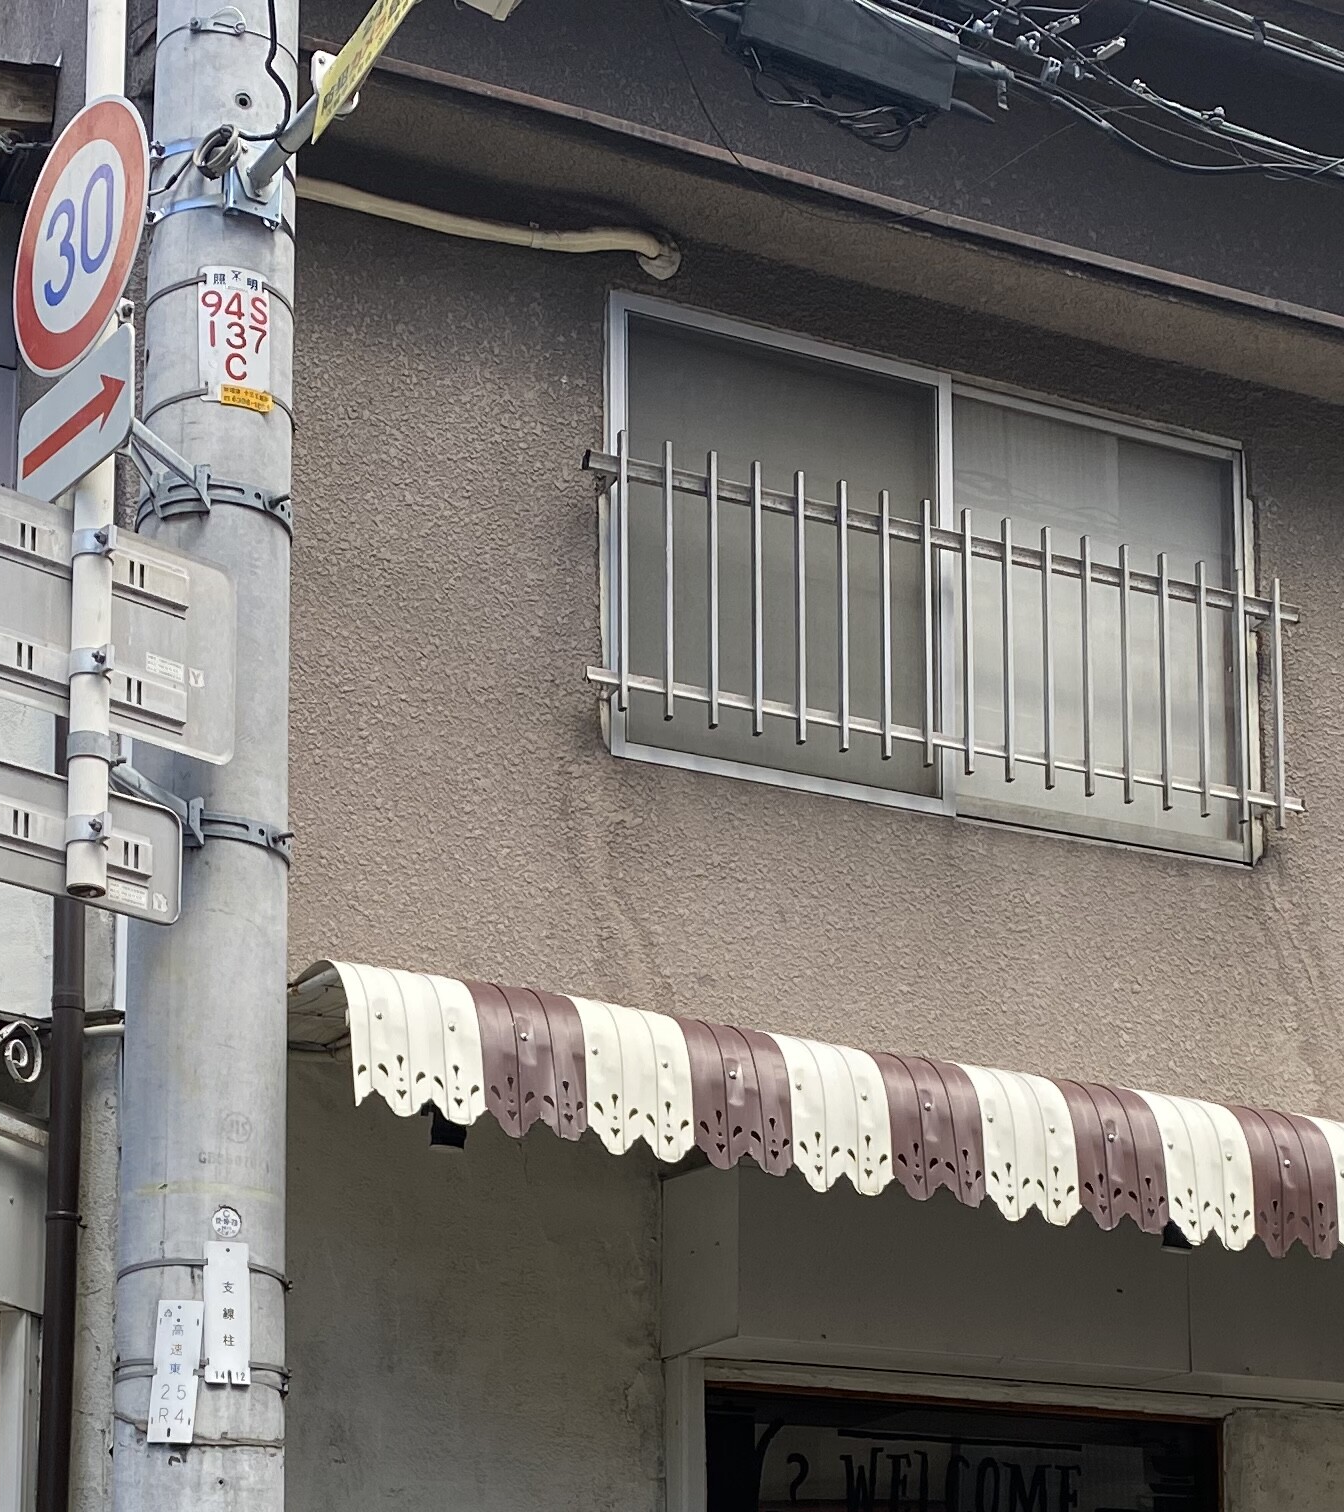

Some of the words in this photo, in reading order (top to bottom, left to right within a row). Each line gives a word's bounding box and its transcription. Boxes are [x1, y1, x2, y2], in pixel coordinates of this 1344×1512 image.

[44, 164, 114, 306] 30
[201, 290, 268, 325] 94S
[209, 320, 267, 354] 137
[225, 353, 247, 381] C
[222, 1281, 235, 1347] 支線柱
